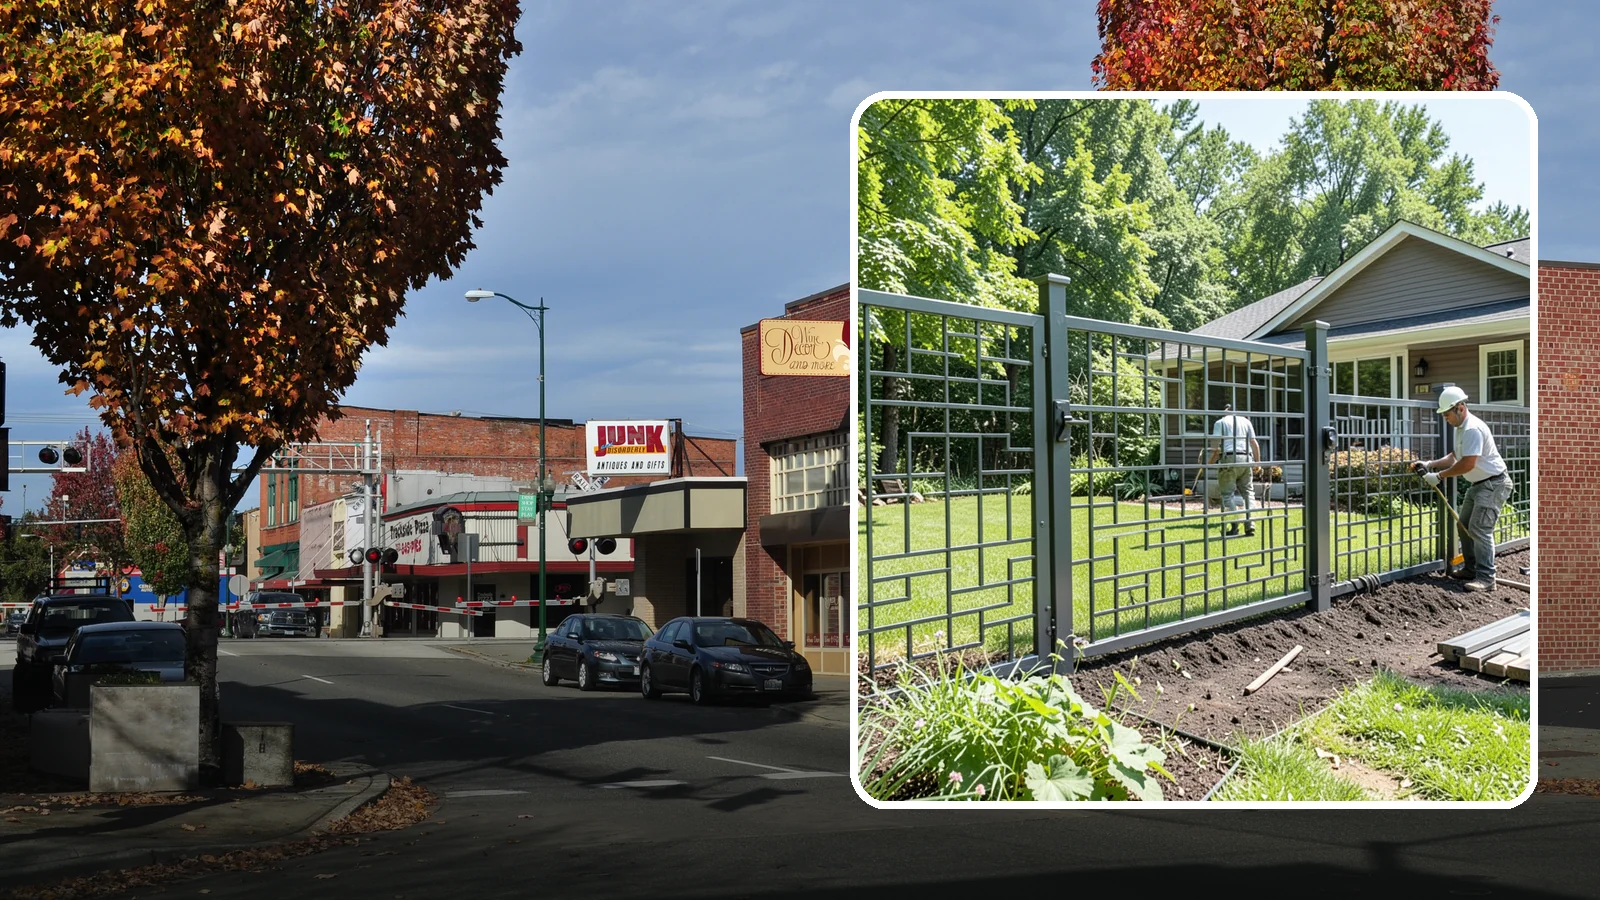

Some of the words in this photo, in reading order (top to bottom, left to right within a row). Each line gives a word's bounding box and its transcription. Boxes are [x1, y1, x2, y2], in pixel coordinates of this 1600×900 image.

[595, 425, 666, 457] JUNK
[597, 461, 628, 470] ANTIQUES
[631, 461, 644, 470] AND
[647, 460, 666, 470] GIFTS
[573, 473, 588, 491] RAIL
[414, 519, 429, 535] Pizza
